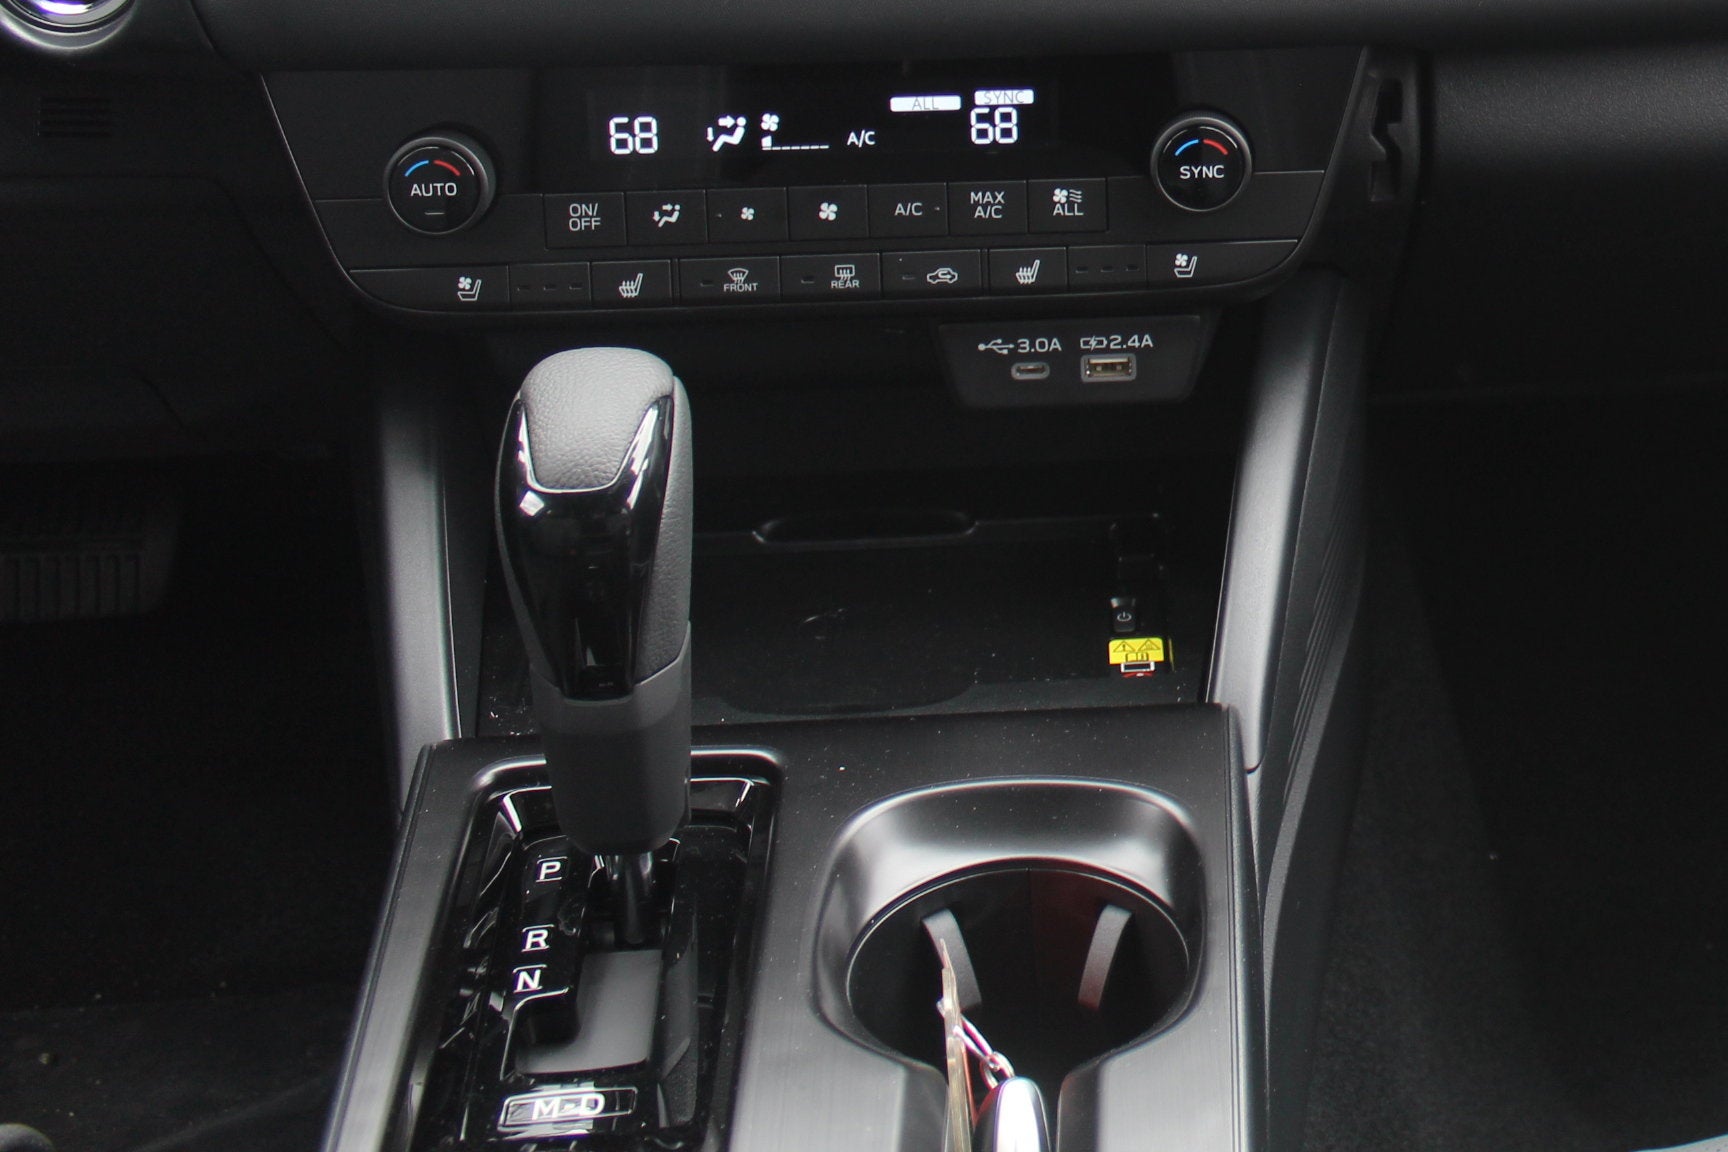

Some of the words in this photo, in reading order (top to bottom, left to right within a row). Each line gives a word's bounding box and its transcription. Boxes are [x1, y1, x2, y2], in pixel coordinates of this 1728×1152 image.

[910, 97, 940, 110] ALL
[983, 91, 1025, 104] SYNC
[970, 107, 1018, 145] 68
[608, 115, 659, 155] 68
[846, 131, 876, 147] A/C
[1179, 164, 1225, 180] SYNC
[410, 182, 458, 197] AUTO
[969, 191, 1005, 206] MAX
[569, 203, 599, 218] ON/
[894, 203, 923, 217] A/C
[973, 205, 1003, 219] A/C
[1052, 202, 1084, 217] ALL
[568, 218, 601, 232] OFF
[723, 282, 758, 293] FRONT
[830, 278, 860, 289] REAR
[1017, 338, 1062, 353] 3.0A
[1109, 334, 1153, 349] 2.4A
[539, 861, 562, 879] P
[525, 929, 549, 949] R
[516, 970, 542, 990] N
